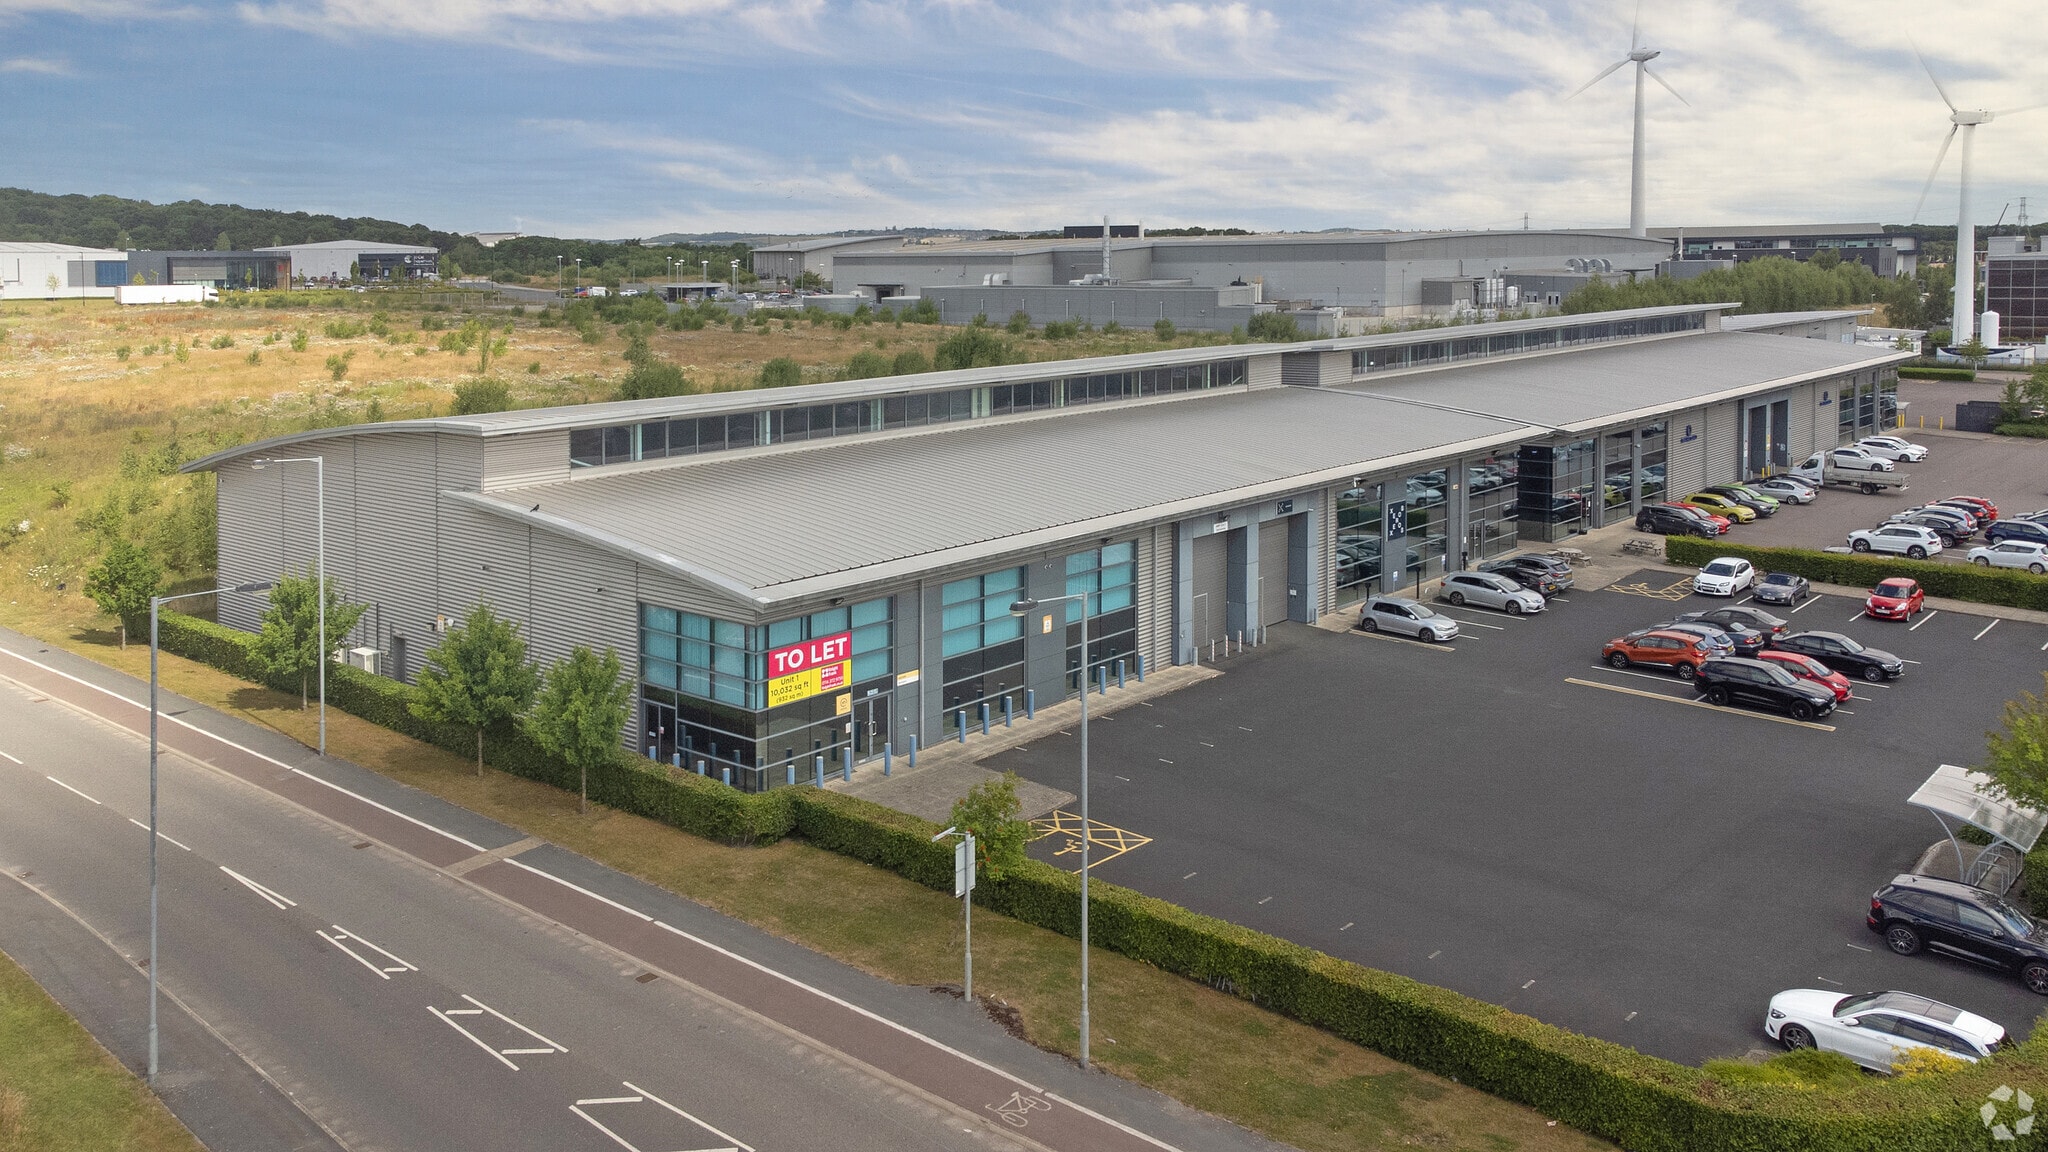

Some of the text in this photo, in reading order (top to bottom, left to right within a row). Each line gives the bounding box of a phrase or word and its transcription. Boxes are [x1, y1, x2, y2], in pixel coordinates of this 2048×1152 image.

[774, 637, 847, 672] TO LET
[781, 676, 795, 685] Unit
[771, 685, 792, 697] 10,032
[794, 683, 802, 691] sq
